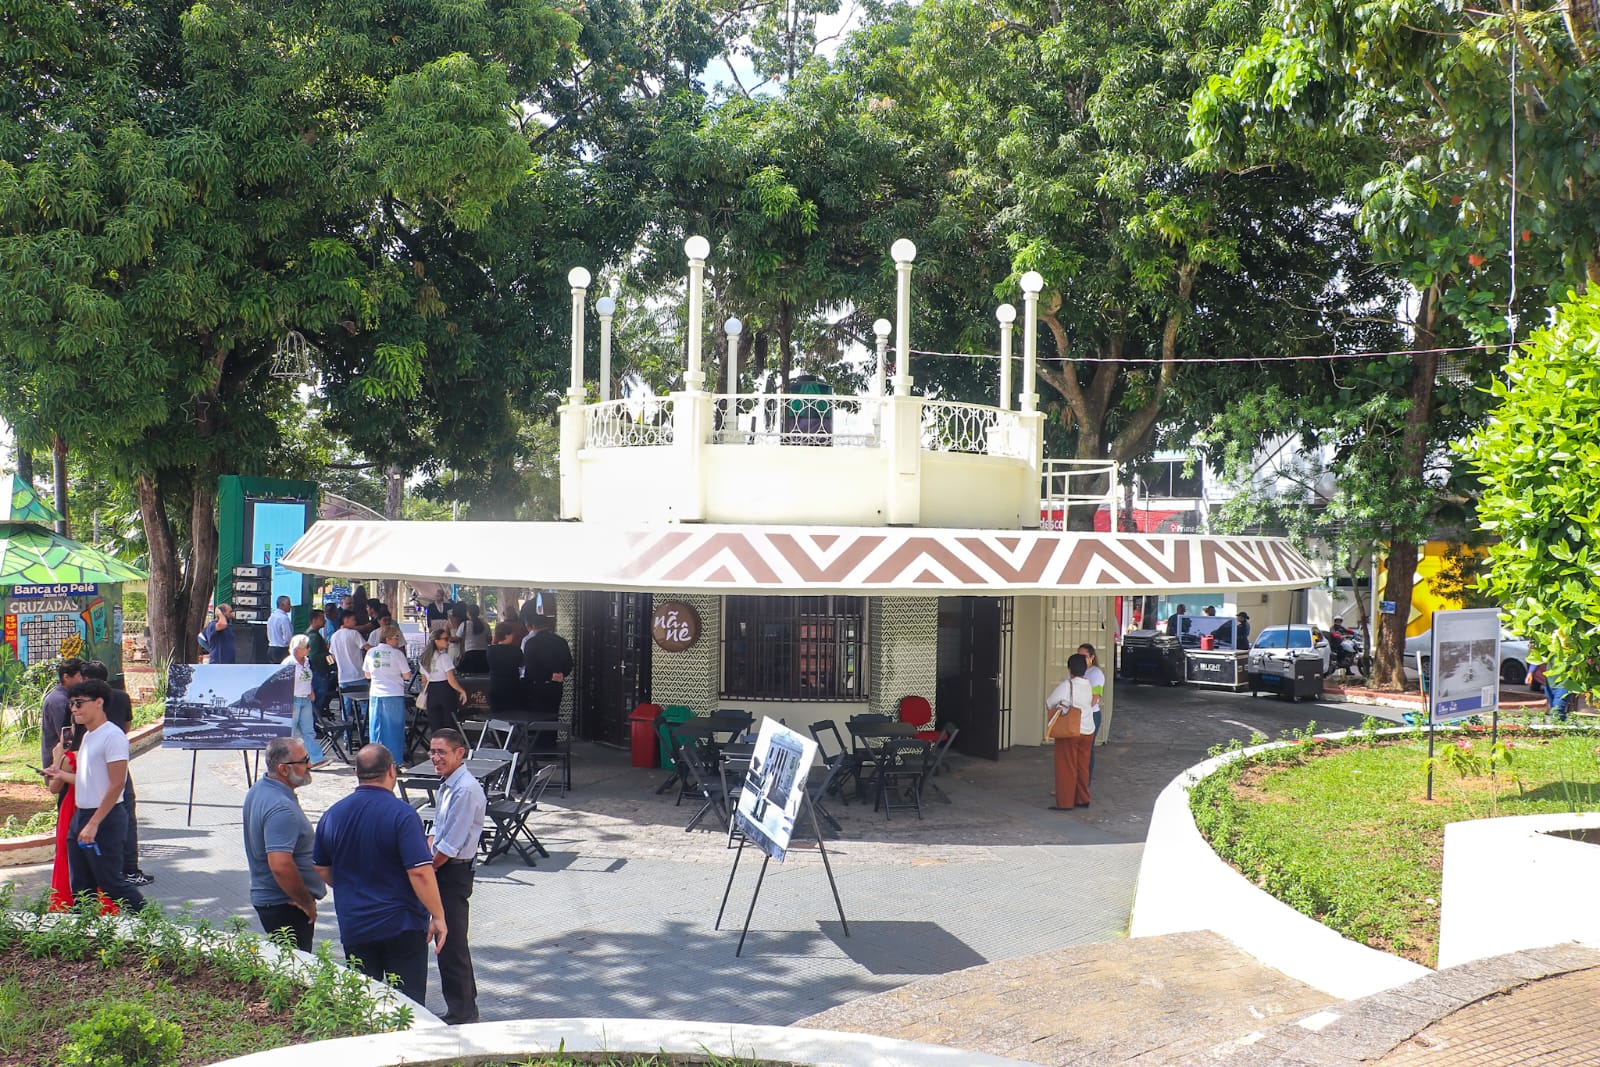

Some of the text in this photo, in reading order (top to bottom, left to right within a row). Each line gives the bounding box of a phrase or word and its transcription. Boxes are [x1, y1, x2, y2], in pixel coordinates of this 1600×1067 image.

[14, 583, 95, 595] Banca do Pelé
[9, 600, 79, 613] CRUZADAS
[654, 611, 681, 629] nã
[666, 621, 692, 642] nê
